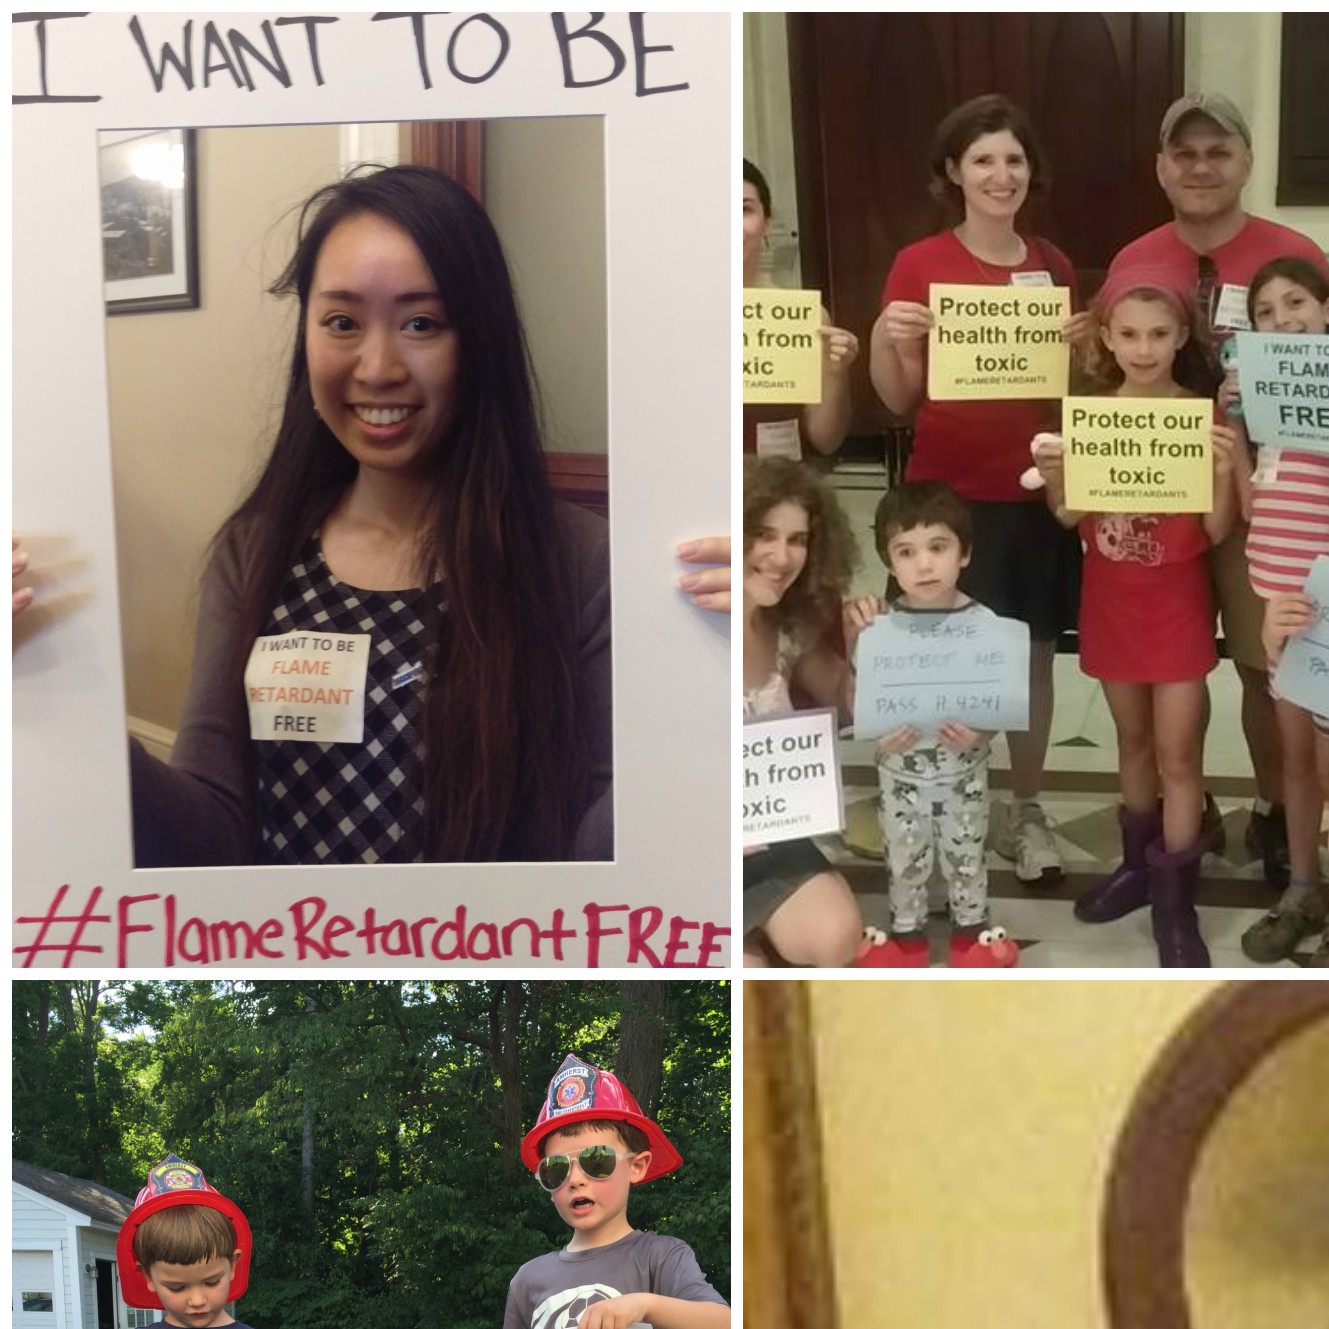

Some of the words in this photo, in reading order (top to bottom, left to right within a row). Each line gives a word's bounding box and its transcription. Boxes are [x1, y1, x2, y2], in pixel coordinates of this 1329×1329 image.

[12, 12, 103, 105] I
[128, 15, 340, 93] WANT
[371, 12, 510, 89] TO
[550, 12, 690, 97] BE
[771, 304, 811, 320] our
[940, 297, 1021, 316] Protect
[1027, 302, 1063, 316] our
[758, 329, 812, 348] from
[938, 325, 1007, 344] health
[1014, 325, 1063, 344] from
[1271, 344, 1310, 357] WANT
[975, 354, 1028, 372] toxic
[1072, 409, 1156, 429] Protect
[1163, 414, 1204, 430] our
[1071, 437, 1141, 457] health
[1150, 438, 1204, 458] from
[1109, 466, 1166, 485] toxic
[909, 622, 978, 638] PLEASE
[270, 637, 309, 651] WANT
[312, 638, 333, 651] TO
[336, 639, 355, 652] BE
[272, 660, 331, 676] FLAME
[250, 687, 354, 705] RETARDANT
[876, 698, 917, 715] PASS
[956, 694, 1001, 712] 4241
[273, 715, 316, 733] FREE
[782, 734, 822, 752] our
[768, 763, 825, 784] from
